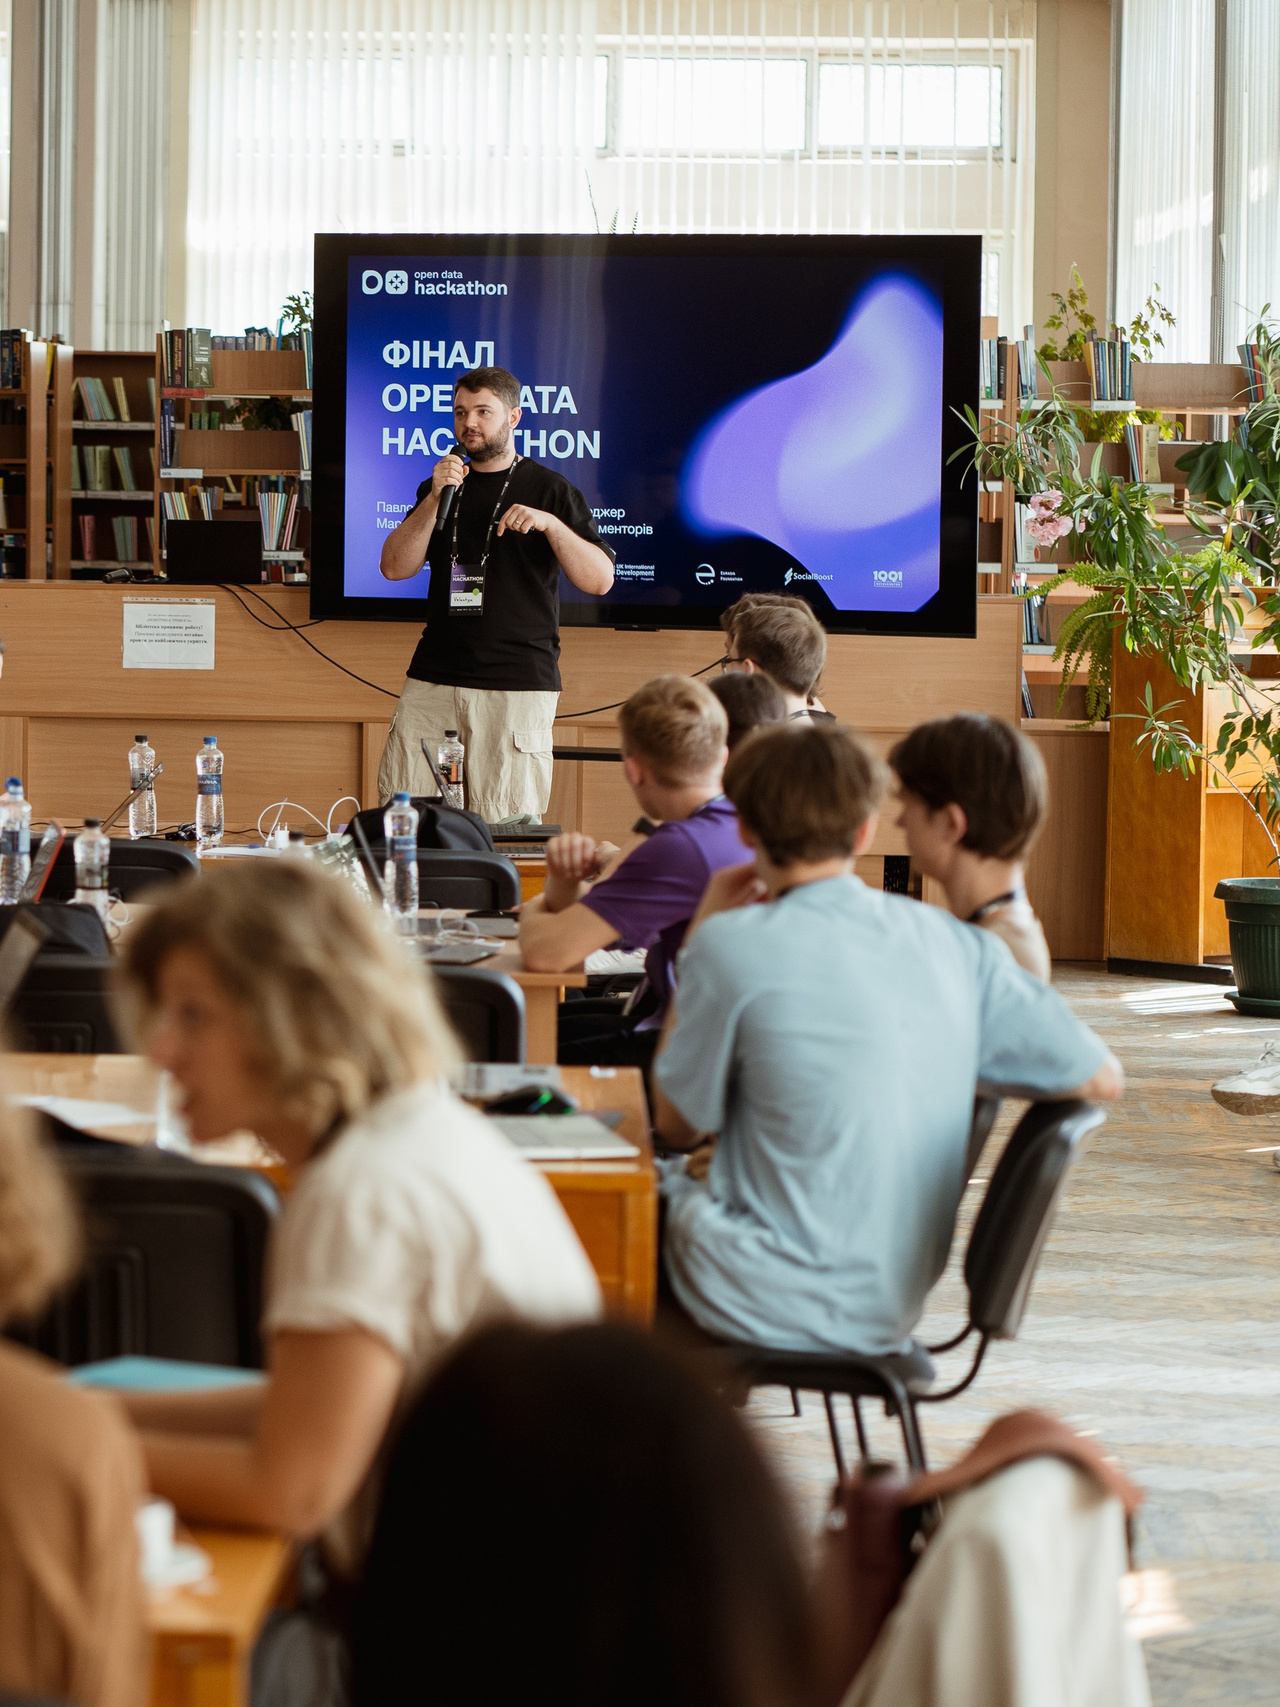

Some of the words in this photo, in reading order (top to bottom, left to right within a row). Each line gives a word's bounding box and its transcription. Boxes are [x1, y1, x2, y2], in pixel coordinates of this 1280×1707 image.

[414, 272, 439, 281] open
[441, 270, 463, 279] data
[414, 280, 508, 296] hackathon
[382, 340, 495, 370] ФІНАЛ
[381, 383, 453, 413] OPE
[519, 385, 578, 414] ATA
[598, 523, 654, 538] менторів
[616, 569, 655, 577] Development
[793, 572, 834, 581] SocialBoost
[873, 570, 903, 582] 1001
